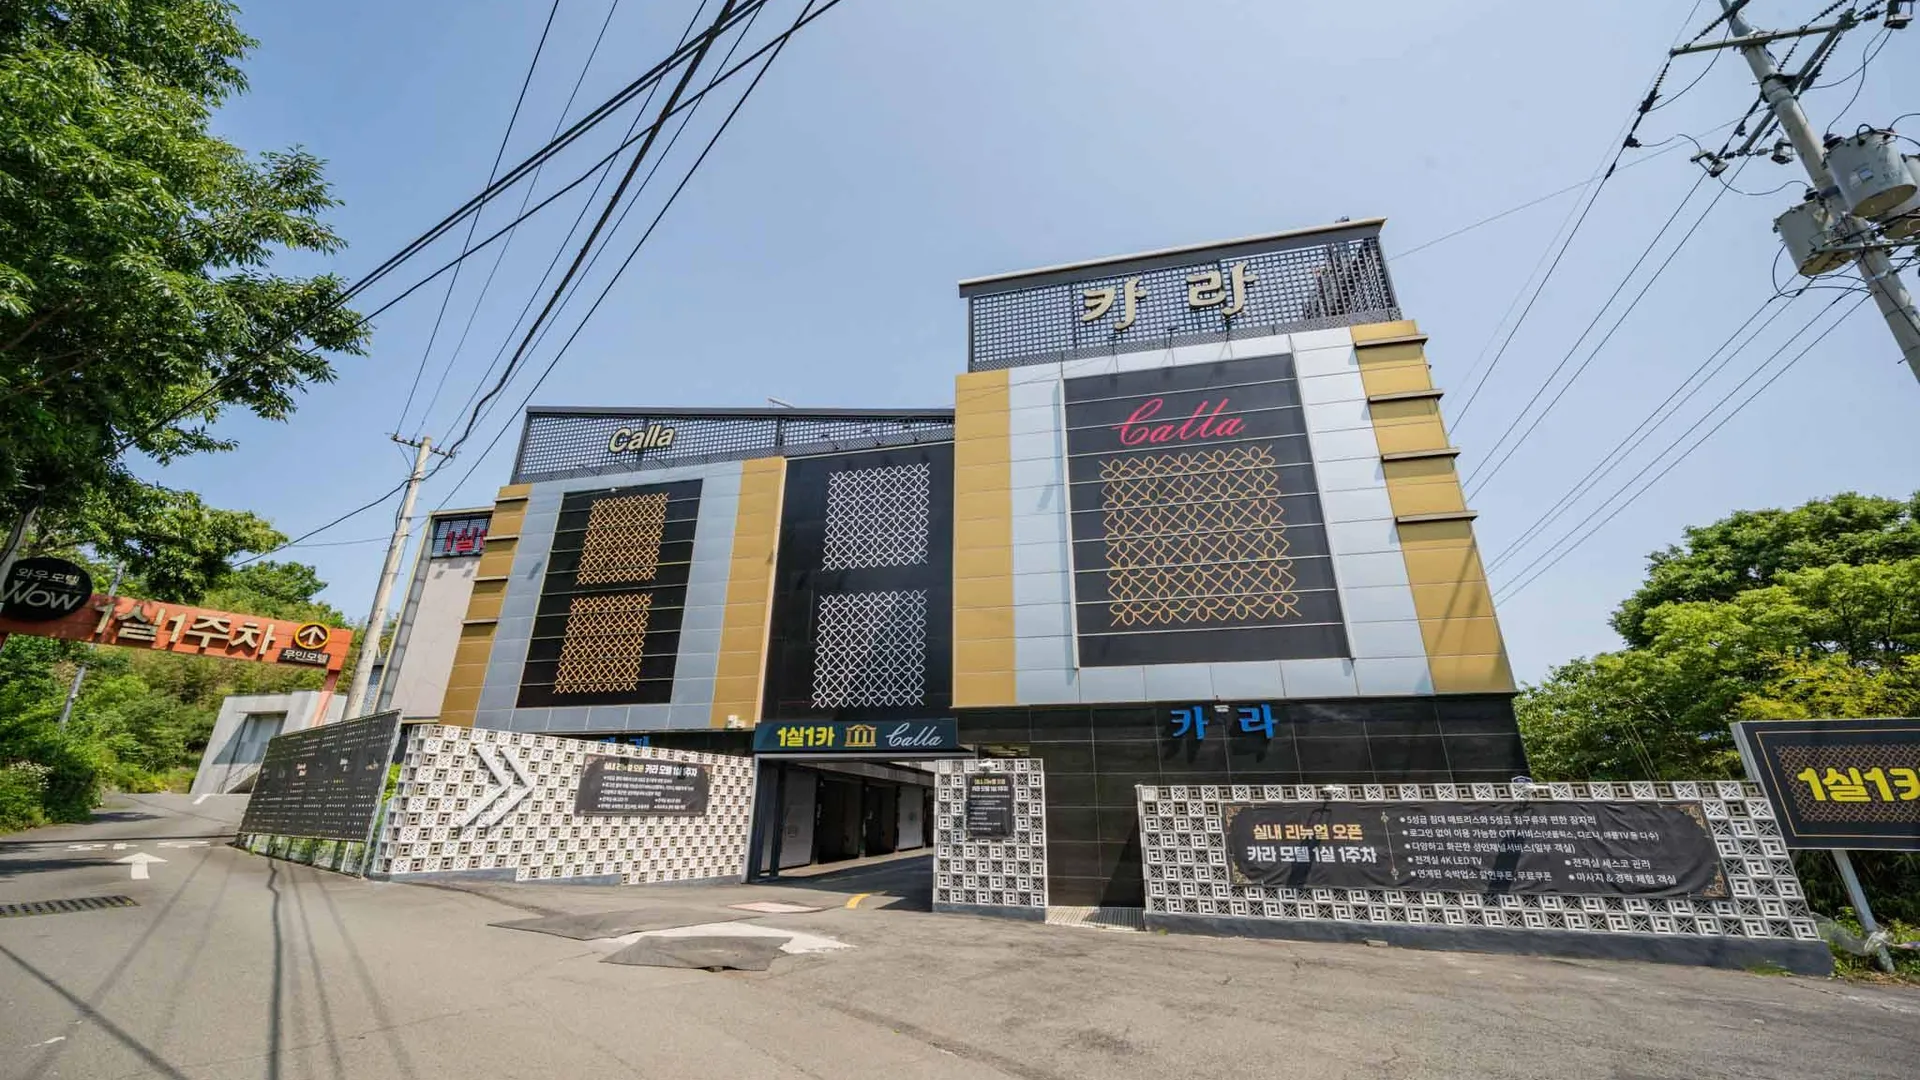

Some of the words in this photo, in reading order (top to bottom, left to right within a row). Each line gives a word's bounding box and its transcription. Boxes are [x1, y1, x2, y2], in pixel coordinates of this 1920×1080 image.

[1110, 398, 1247, 446] Calla
[608, 424, 676, 453] Calla
[16, 567, 48, 580] 와우
[49, 573, 80, 586] 모텔
[95, 602, 276, 656] 1실1주차
[284, 648, 329, 665] 무인모텔
[776, 726, 836, 747] 1실1카
[886, 722, 943, 747] Calla
[1406, 814, 1427, 825] 5성급
[1447, 814, 1488, 825] 매트리스와
[1489, 815, 1511, 825] 5성급
[1512, 815, 1548, 825] 침구류와
[1550, 815, 1567, 825] 편한
[1569, 815, 1597, 826] 잠자리
[1253, 824, 1282, 841] 실내
[1285, 824, 1330, 841] 리뉴얼
[1333, 824, 1364, 841] 오픈
[1409, 828, 1434, 838] 로그인
[1435, 828, 1452, 838] 없이
[1453, 828, 1470, 838] 이용
[1472, 829, 1498, 839] 가능한
[1247, 846, 1277, 863] 카라
[1280, 846, 1311, 863] 모텔
[1313, 846, 1336, 863] 1실
[1338, 846, 1377, 864] 1주차
[1411, 842, 1444, 852] 다양하고
[1446, 842, 1471, 852] 화끈한
[1555, 843, 1576, 854] 객실)
[1415, 855, 1439, 865] 전객실
[1440, 856, 1453, 865] 4K
[1453, 856, 1470, 866] LED
[1470, 856, 1482, 866] TV
[1573, 858, 1600, 868] 전객실
[1603, 859, 1630, 868] 세스코
[1631, 859, 1651, 870] 관리
[1417, 869, 1442, 879] 연계된
[1444, 869, 1478, 880] 숙박업소
[1518, 871, 1552, 881] 무료쿠폰
[1576, 872, 1605, 882] 마사지
[1606, 874, 1614, 883] &
[1657, 875, 1677, 885] 객실
